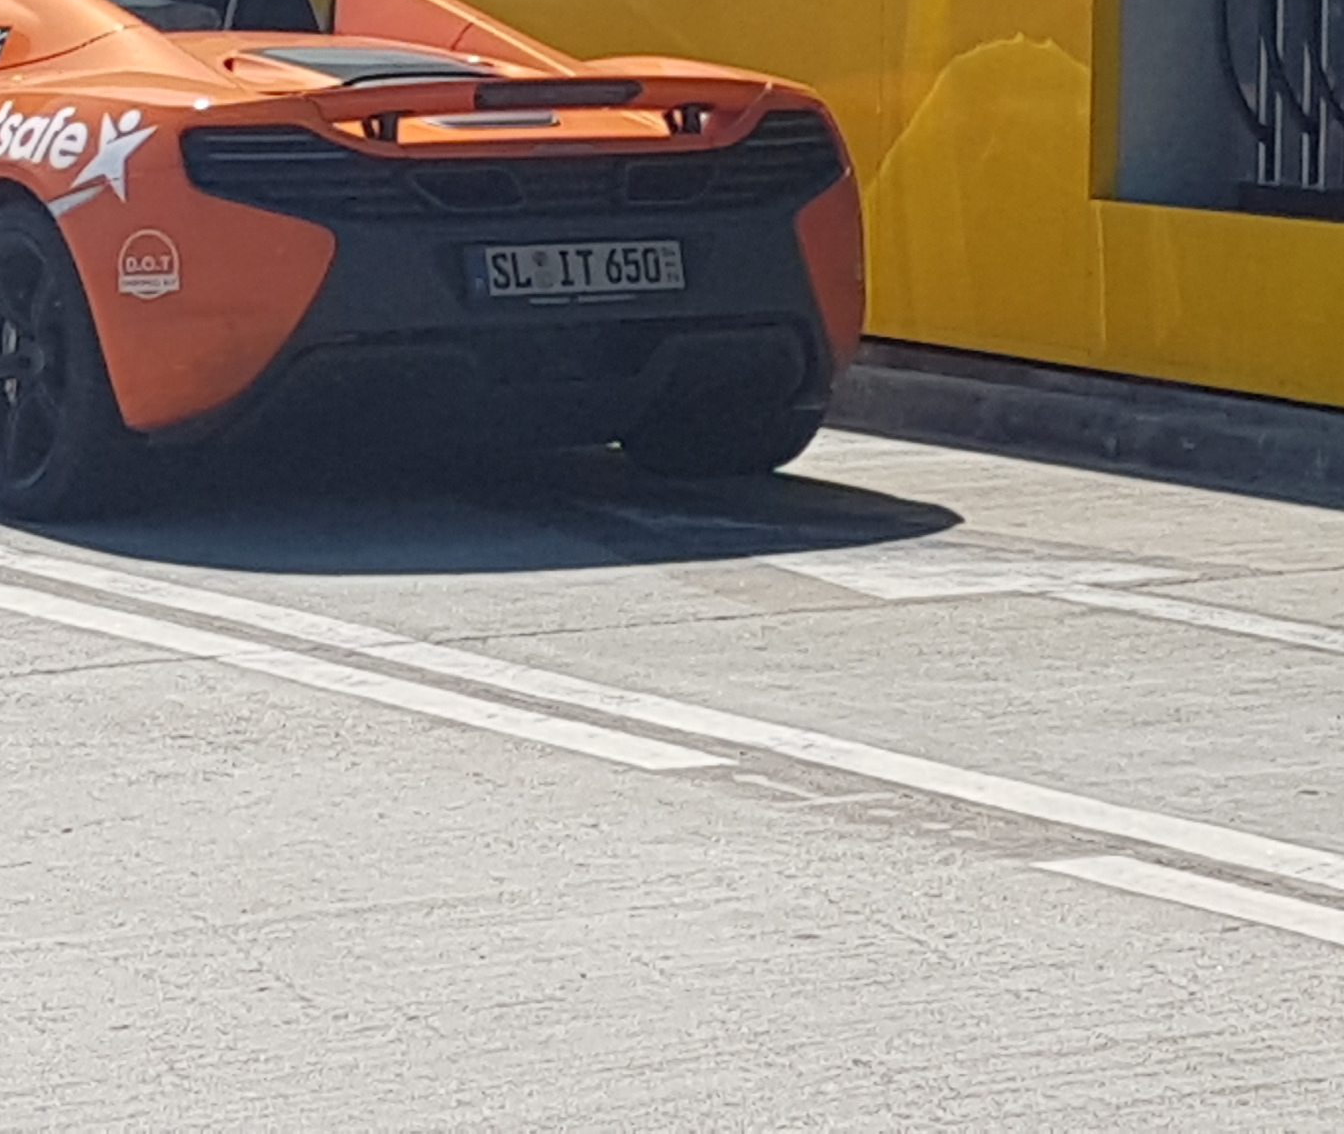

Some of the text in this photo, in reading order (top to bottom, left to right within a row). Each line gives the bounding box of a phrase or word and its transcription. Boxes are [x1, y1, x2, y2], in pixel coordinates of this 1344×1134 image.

[490, 251, 532, 290] SL
[558, 249, 594, 287] IT
[605, 247, 662, 285] 650
